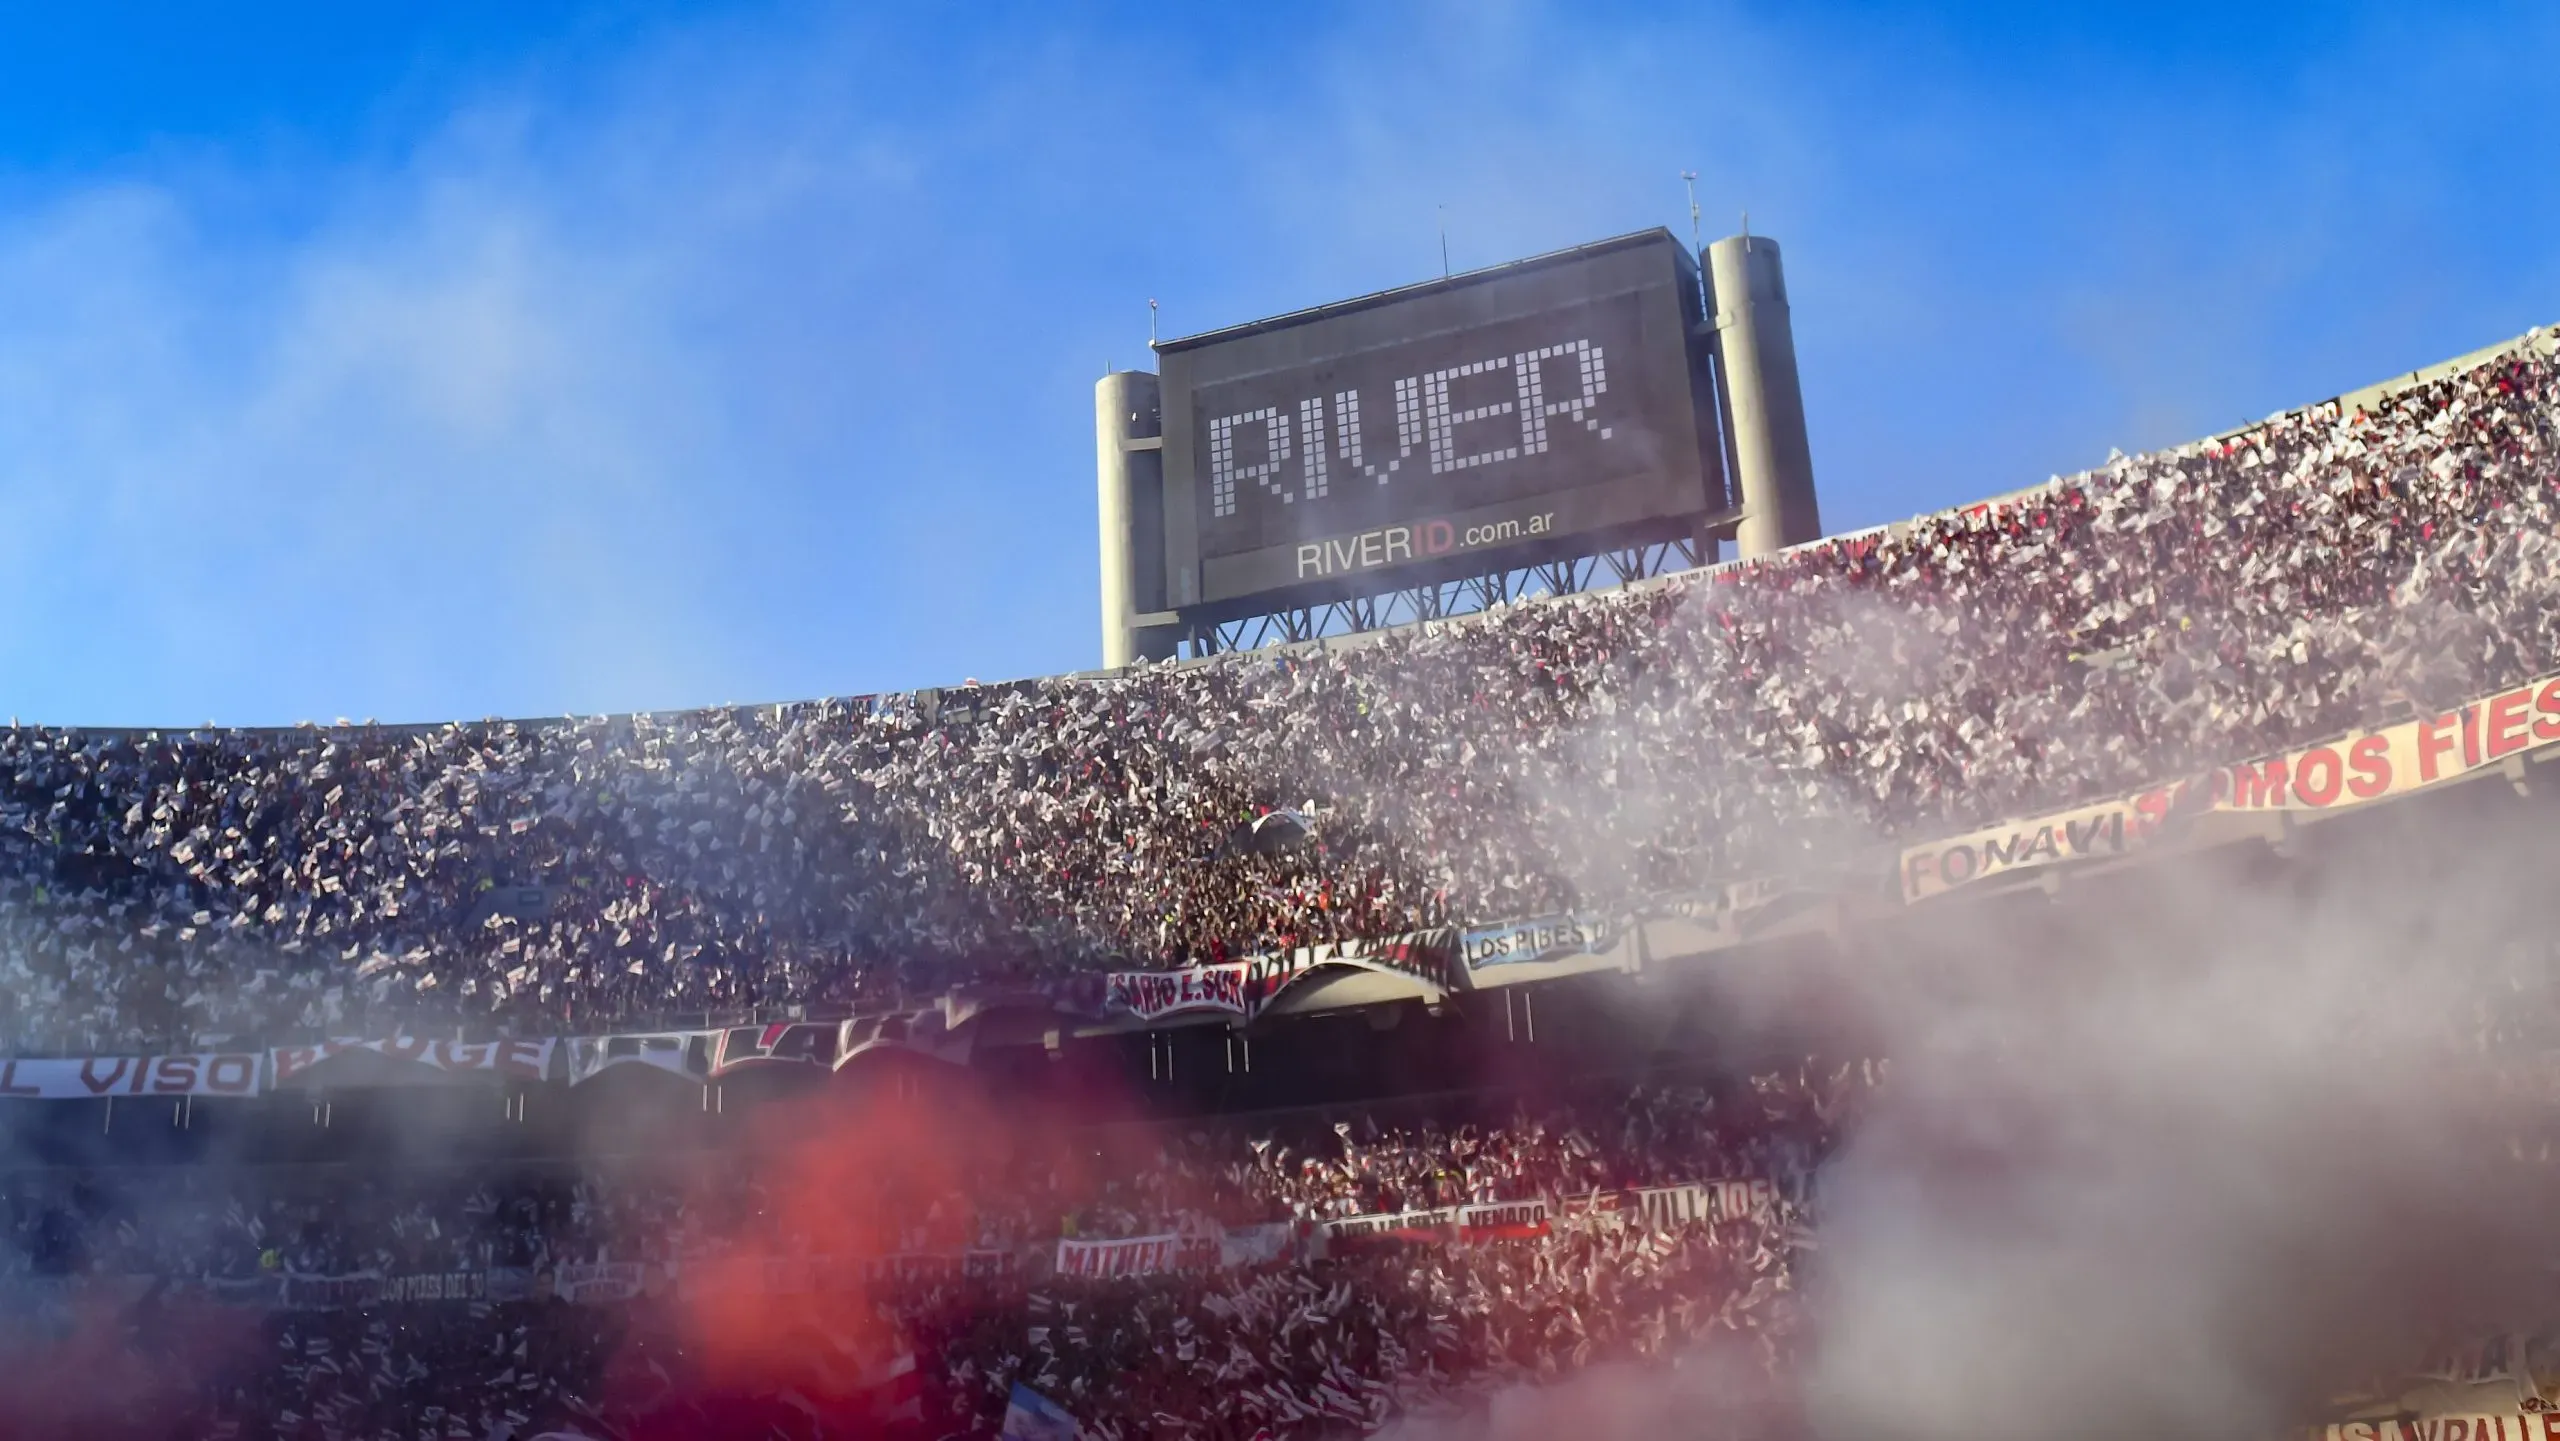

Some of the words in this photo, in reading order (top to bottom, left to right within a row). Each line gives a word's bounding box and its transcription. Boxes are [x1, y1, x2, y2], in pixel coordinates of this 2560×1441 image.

[1210, 339, 1613, 518] RIVER
[1907, 811, 2124, 898] FONAVI
[1466, 935, 1510, 970] LOS
[1515, 915, 1584, 951] PIBES
[80, 1055, 253, 1095] VISO
[1468, 1205, 1546, 1231] VENADO
